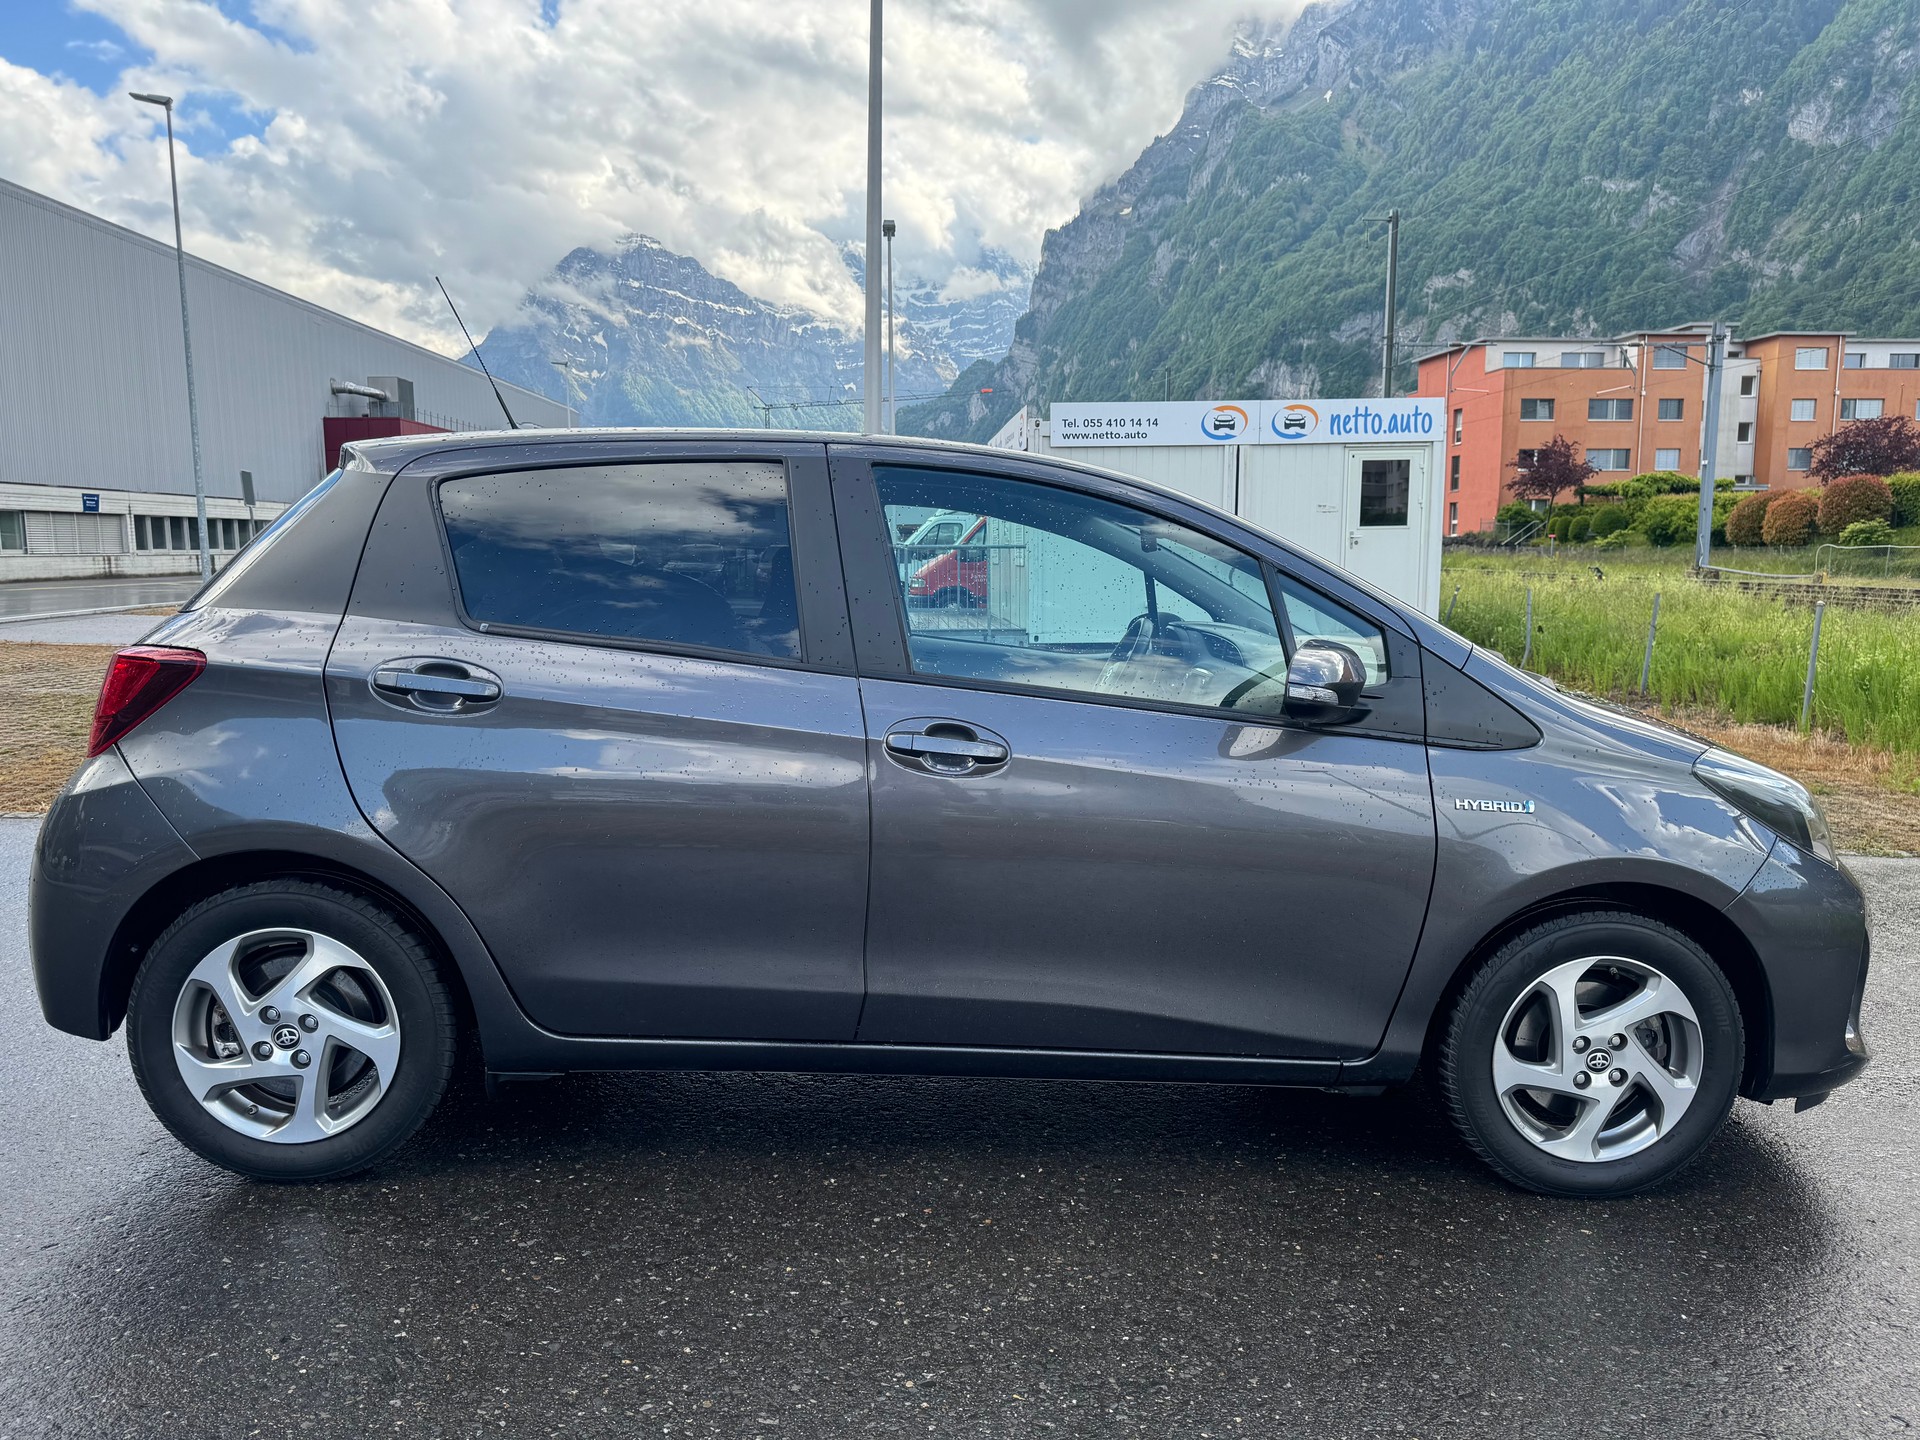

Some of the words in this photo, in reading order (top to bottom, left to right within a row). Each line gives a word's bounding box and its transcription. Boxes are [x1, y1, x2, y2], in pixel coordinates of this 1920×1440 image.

[1061, 418, 1080, 428] Tel.
[1082, 418, 1103, 428] 055
[1105, 418, 1126, 428] 410
[1129, 418, 1142, 428] 14
[1146, 417, 1159, 428] 14
[1329, 404, 1433, 436] netto.auto
[1061, 430, 1148, 440] www.netto.auto
[1455, 798, 1524, 813] HYBRID
